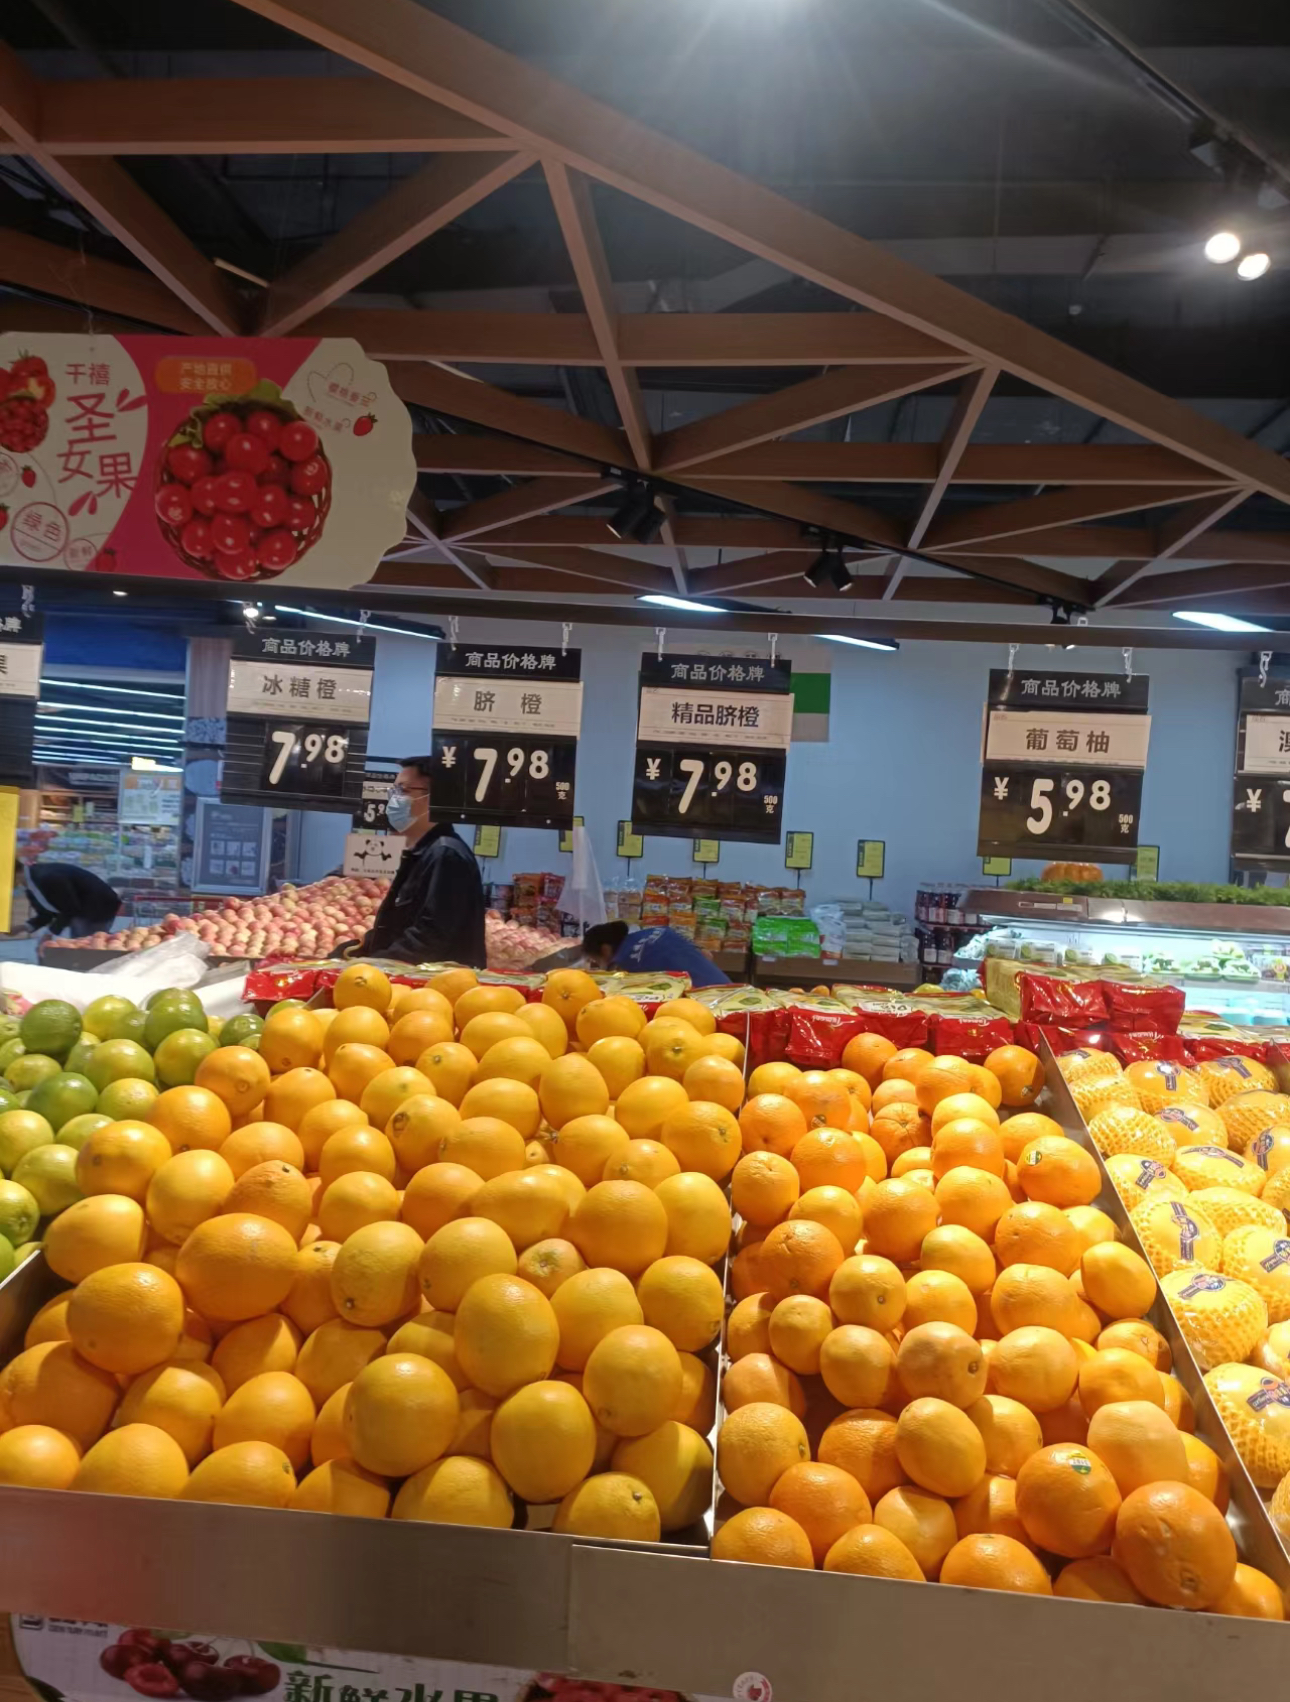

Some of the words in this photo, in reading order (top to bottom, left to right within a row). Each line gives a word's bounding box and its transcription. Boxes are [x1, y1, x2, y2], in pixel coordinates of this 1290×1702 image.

[66, 363, 110, 386] 千禧
[0, 617, 22, 633] 牌
[262, 637, 350, 657] 商品价格牌
[465, 652, 557, 670] 商品价格牌
[671, 663, 765, 682] 商品价格牌
[262, 674, 337, 700] 冰糖橙
[1021, 679, 1121, 698] 商品价格牌
[671, 702, 760, 728] 精品脐橙
[1026, 728, 1110, 753] 葡萄柚
[268, 731, 345, 785] 7.98
[473, 747, 549, 802] 7.98
[678, 759, 757, 814] 7.98
[1026, 778, 1111, 835] 5.98
